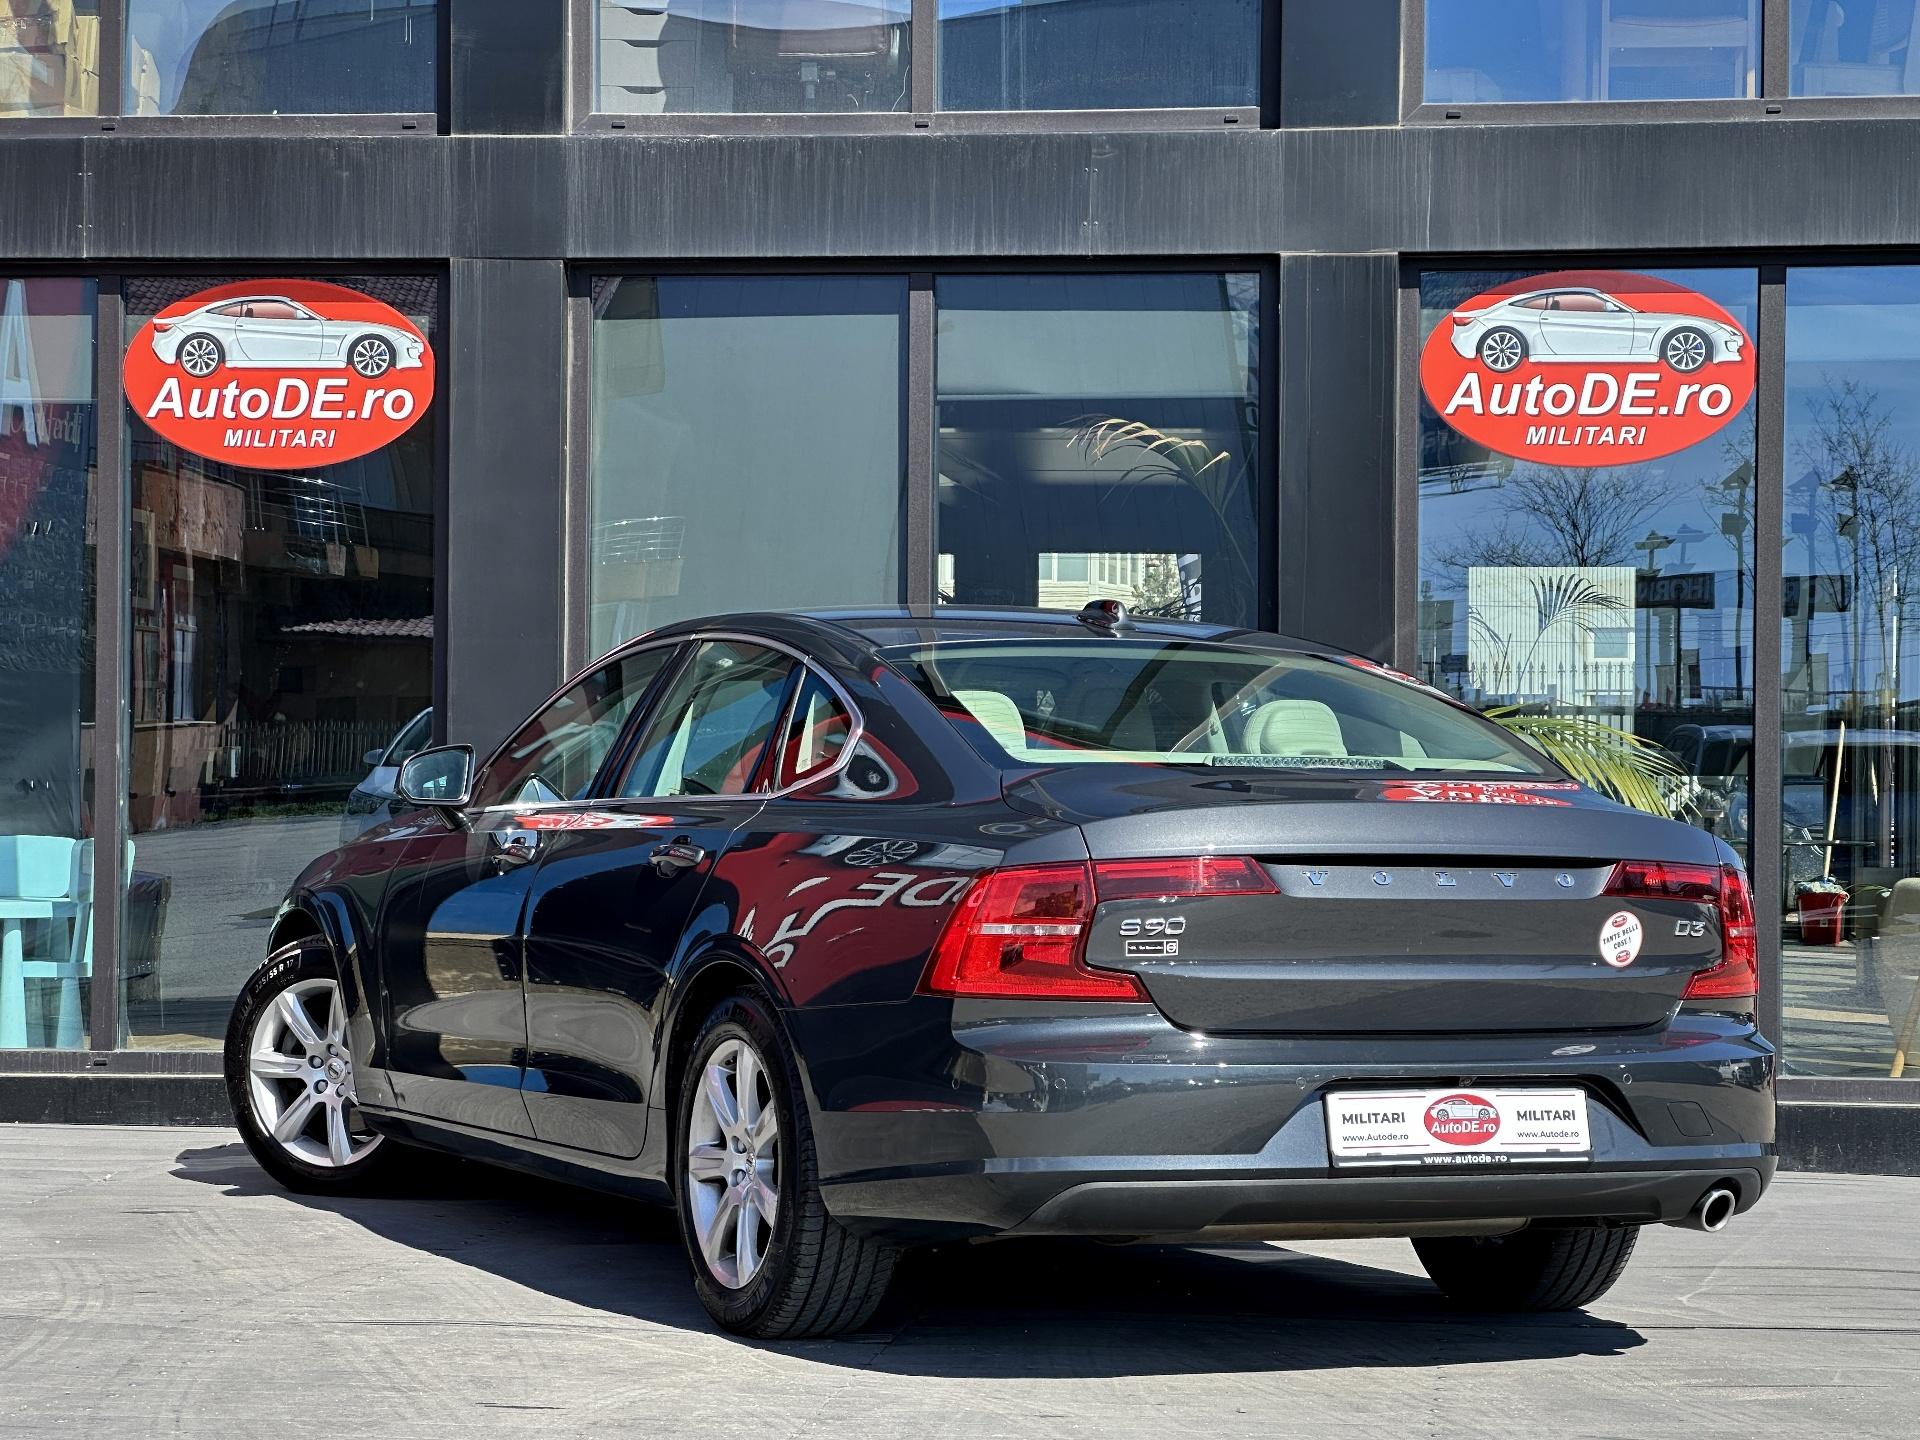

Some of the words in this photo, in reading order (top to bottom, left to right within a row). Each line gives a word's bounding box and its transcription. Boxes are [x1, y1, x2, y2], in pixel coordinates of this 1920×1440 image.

[145, 377, 415, 421] AutoDE.ro
[1444, 372, 1733, 416] AutoDE.ro
[223, 429, 337, 449] MILITARI
[1525, 426, 1647, 446] MILITARI
[1302, 870, 1576, 888] VOLVO
[1119, 916, 1187, 936] S90
[1674, 920, 1706, 937] D3
[1342, 1112, 1406, 1125] MILITARI
[1516, 1109, 1577, 1122] MILITARI
[1430, 1120, 1497, 1134] AutoDE.ro
[1517, 1129, 1580, 1139] www.Autode.ro
[1342, 1132, 1409, 1142] www.Autode.ro
[1423, 1154, 1508, 1165] www.autode.ro
